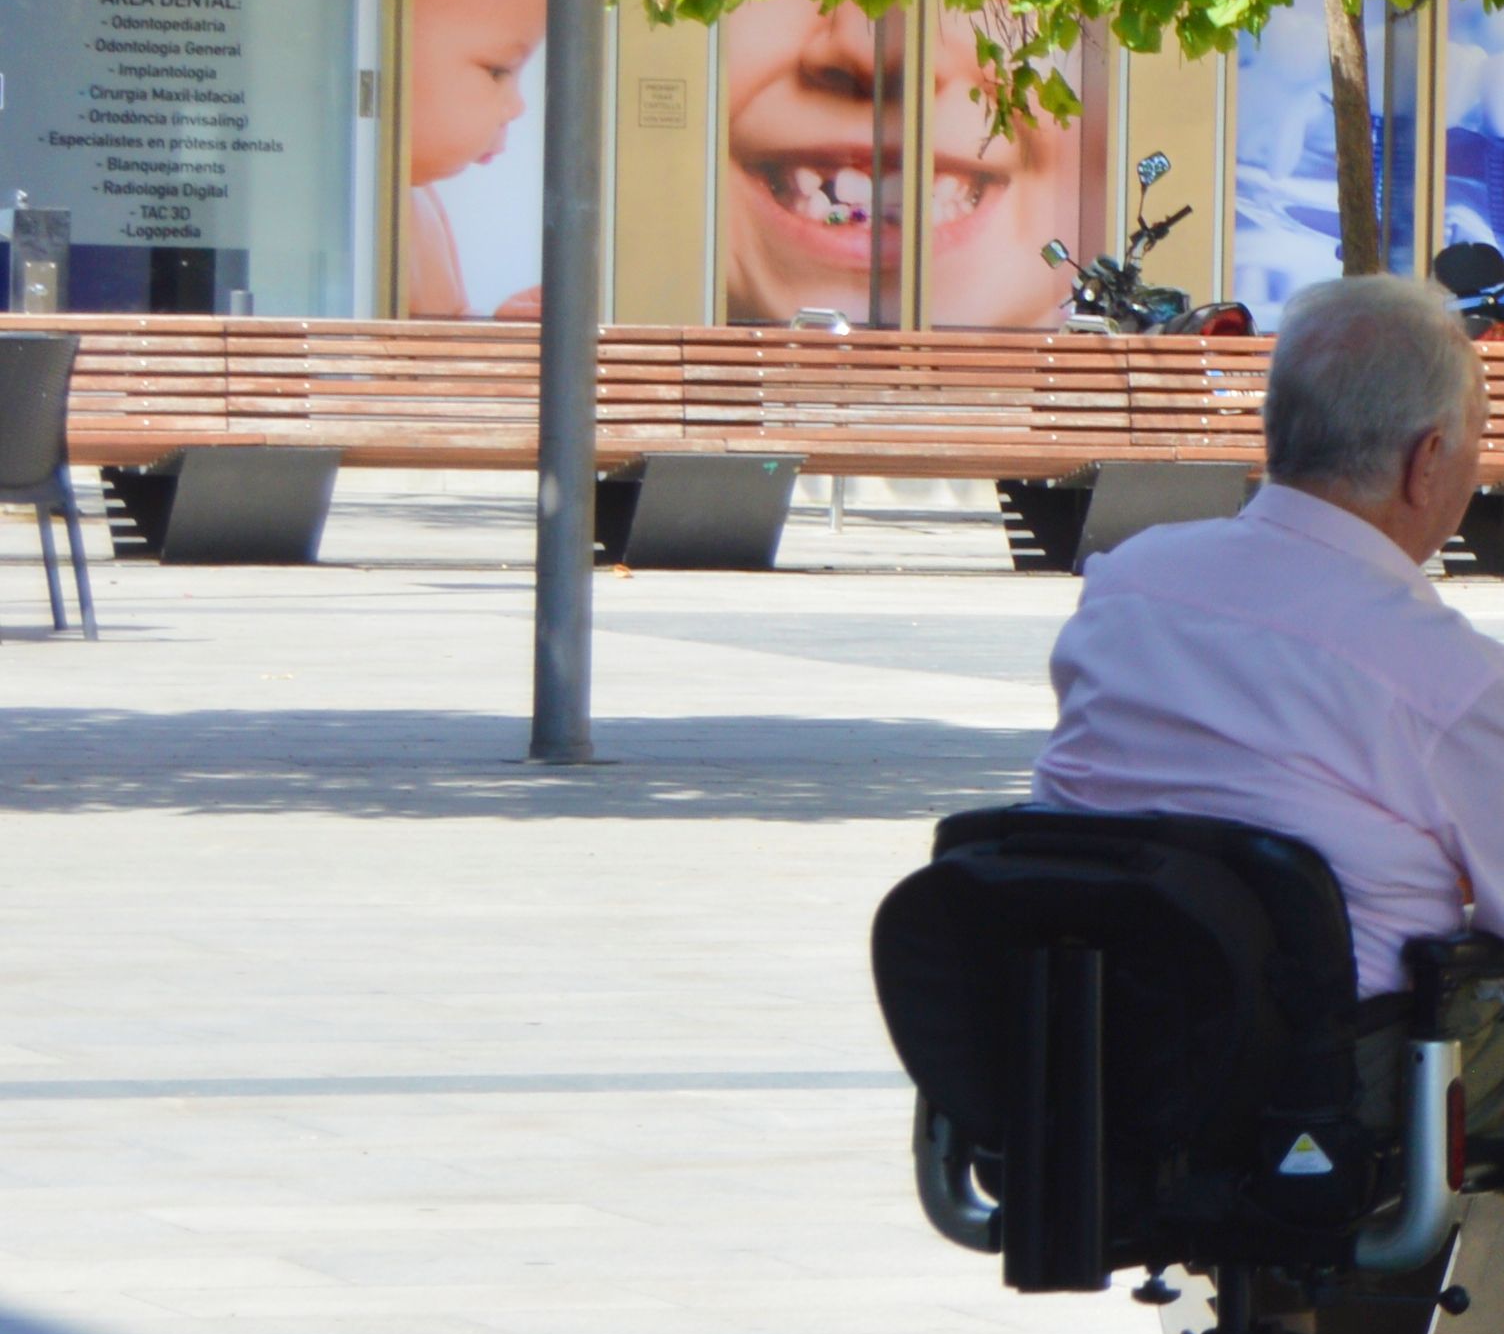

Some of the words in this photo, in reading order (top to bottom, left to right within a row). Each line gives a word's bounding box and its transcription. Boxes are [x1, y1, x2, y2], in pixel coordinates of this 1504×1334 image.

[112, 14, 226, 34] Odontopediatria
[95, 38, 180, 58] Odontologia
[184, 41, 242, 58] General
[118, 63, 217, 82] Implantologia
[89, 84, 148, 105] Cirurgia
[89, 109, 167, 126] Ortodòncia
[49, 130, 144, 149] Especialistes
[147, 137, 165, 149] en
[231, 139, 284, 153] dentals
[107, 156, 226, 176] Blanquejaments
[103, 180, 179, 200] Radiologia
[182, 183, 229, 201] Digital
[140, 205, 170, 221] TAC
[172, 206, 191, 221] 3D
